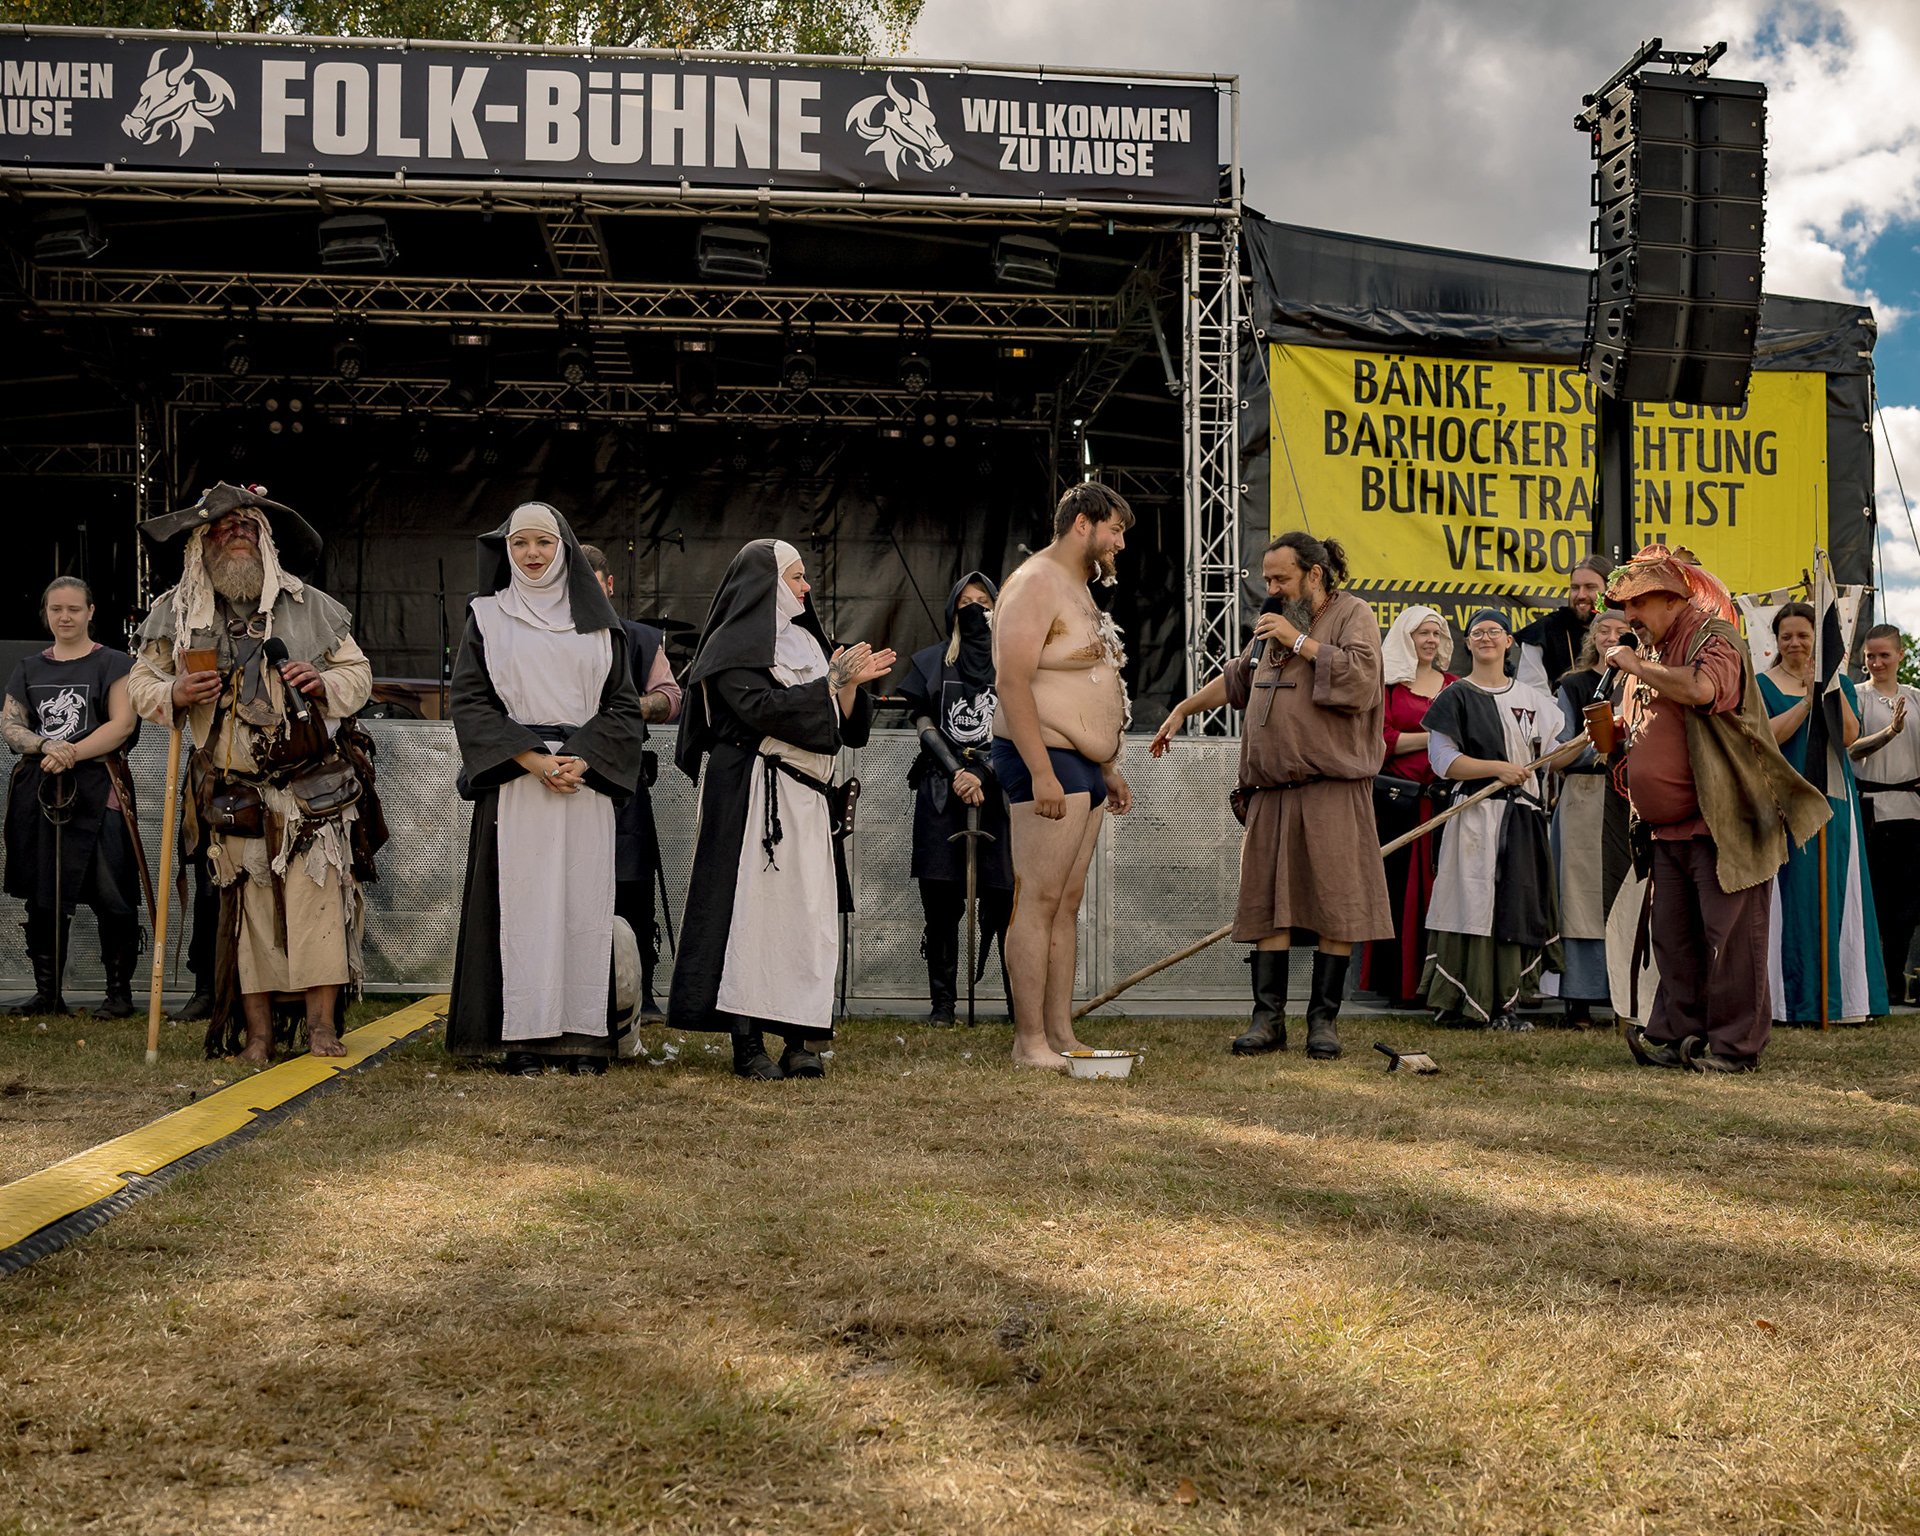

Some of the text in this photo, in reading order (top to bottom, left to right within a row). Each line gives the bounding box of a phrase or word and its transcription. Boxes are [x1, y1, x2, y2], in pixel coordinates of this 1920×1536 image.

[0, 61, 113, 99] MMEN
[261, 60, 821, 171] FOLK-BÜHNE
[961, 97, 1191, 142] WILLKOMMEN
[999, 136, 1154, 177] ZU HAUSE
[1354, 355, 1506, 416] BÄNKE,
[1324, 409, 1777, 475] BARHOCKER RHTUNG
[1362, 461, 1498, 518] BÜHNE
[1685, 481, 1745, 527] IST
